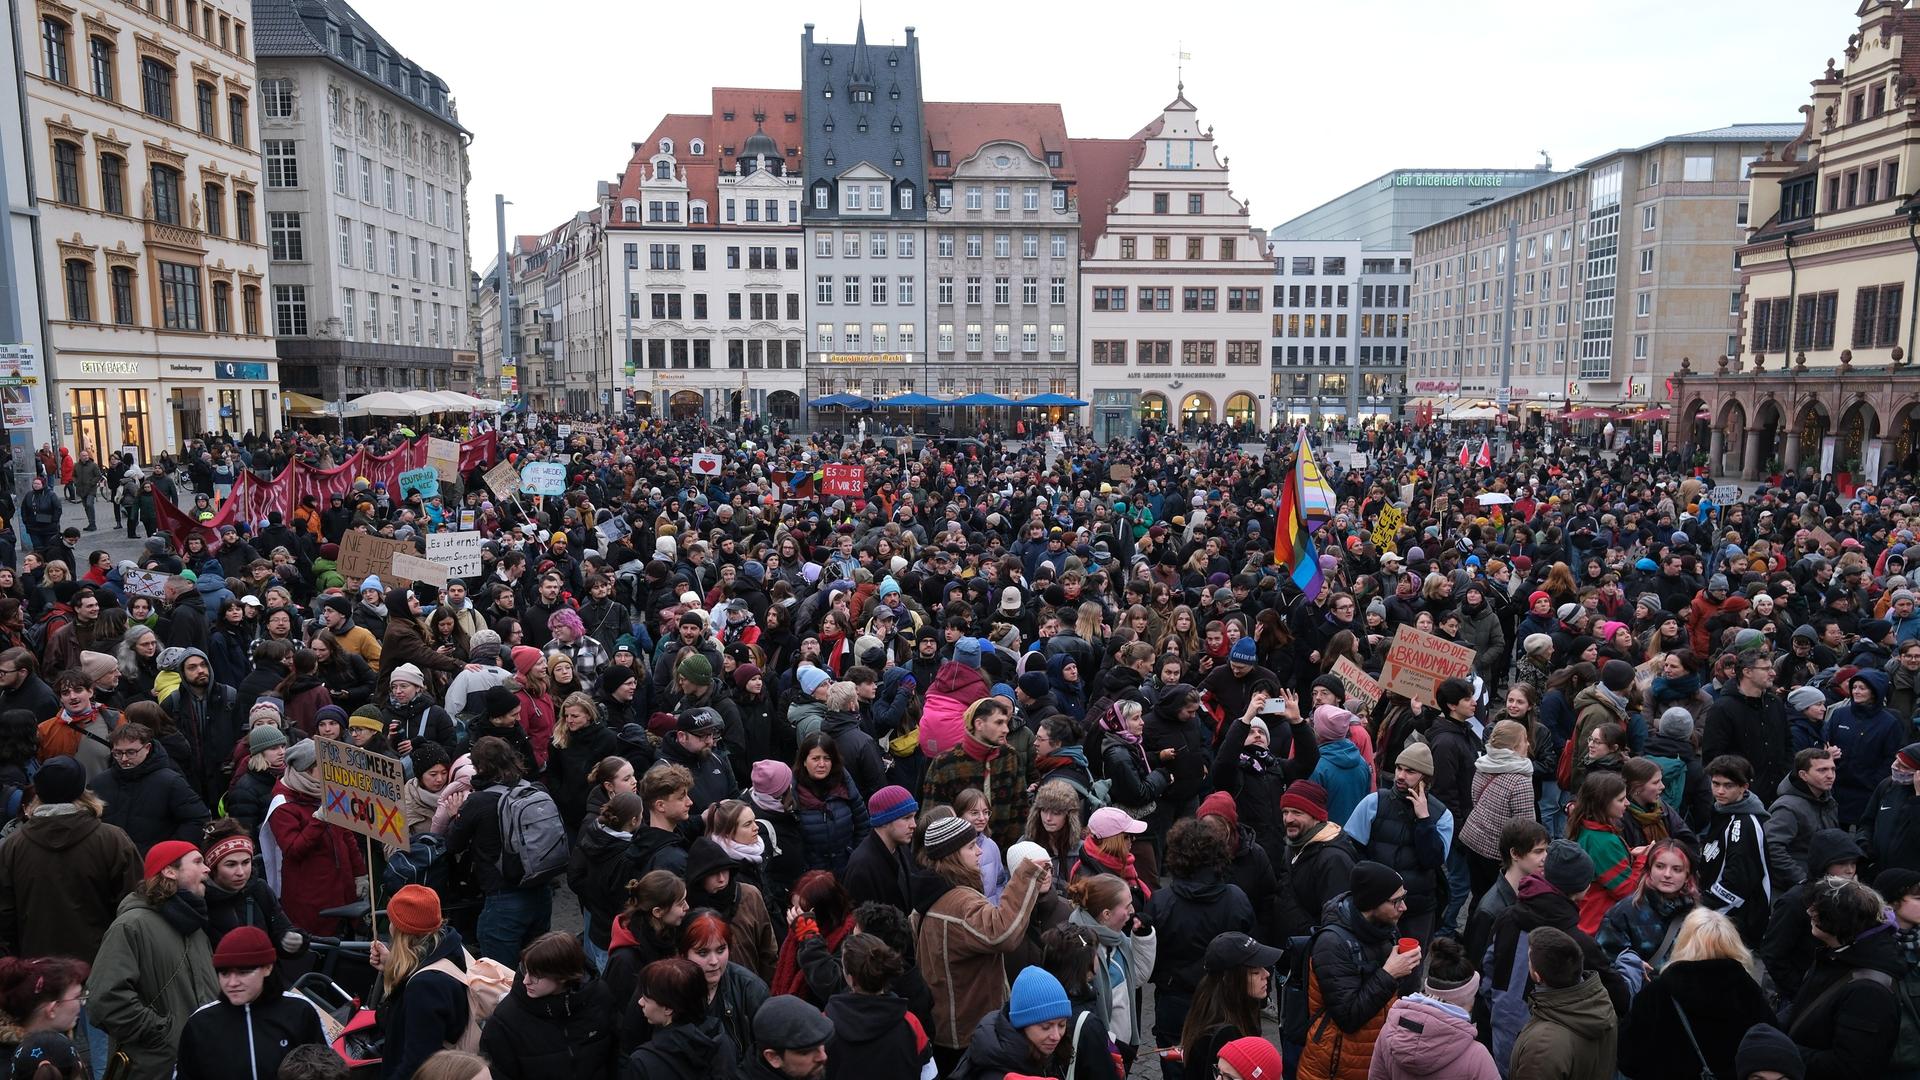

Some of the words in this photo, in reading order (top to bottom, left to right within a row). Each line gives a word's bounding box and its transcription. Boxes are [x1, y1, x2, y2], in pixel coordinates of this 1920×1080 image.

[1396, 175, 1412, 186] der
[1416, 175, 1464, 186] bildenden
[831, 353, 867, 363] Augustiner
[882, 353, 904, 362] Markt
[80, 360, 104, 373] BETTY
[106, 361, 138, 374] BARCLAY
[530, 467, 540, 475] NIE
[543, 466, 563, 476] WIEDER
[826, 466, 838, 477] ES
[850, 468, 862, 478] IST
[531, 476, 542, 484] IST
[545, 478, 562, 489] JETZT
[837, 481, 850, 491] VOR
[851, 480, 861, 492] 33
[346, 534, 361, 554] NIE
[369, 540, 408, 560] WIEDER
[444, 537, 453, 547] ist
[341, 554, 358, 572] IST
[363, 560, 393, 574] JETZ
[1400, 629, 1420, 645] WIR
[1423, 637, 1450, 653] SIND
[1451, 648, 1469, 660] DIE
[1395, 645, 1469, 678] BRANDMAUER
[1340, 661, 1354, 678] NIE
[1356, 671, 1382, 698] WIEDER
[320, 741, 341, 763] FÜR
[345, 747, 401, 779] SCHMERZ-
